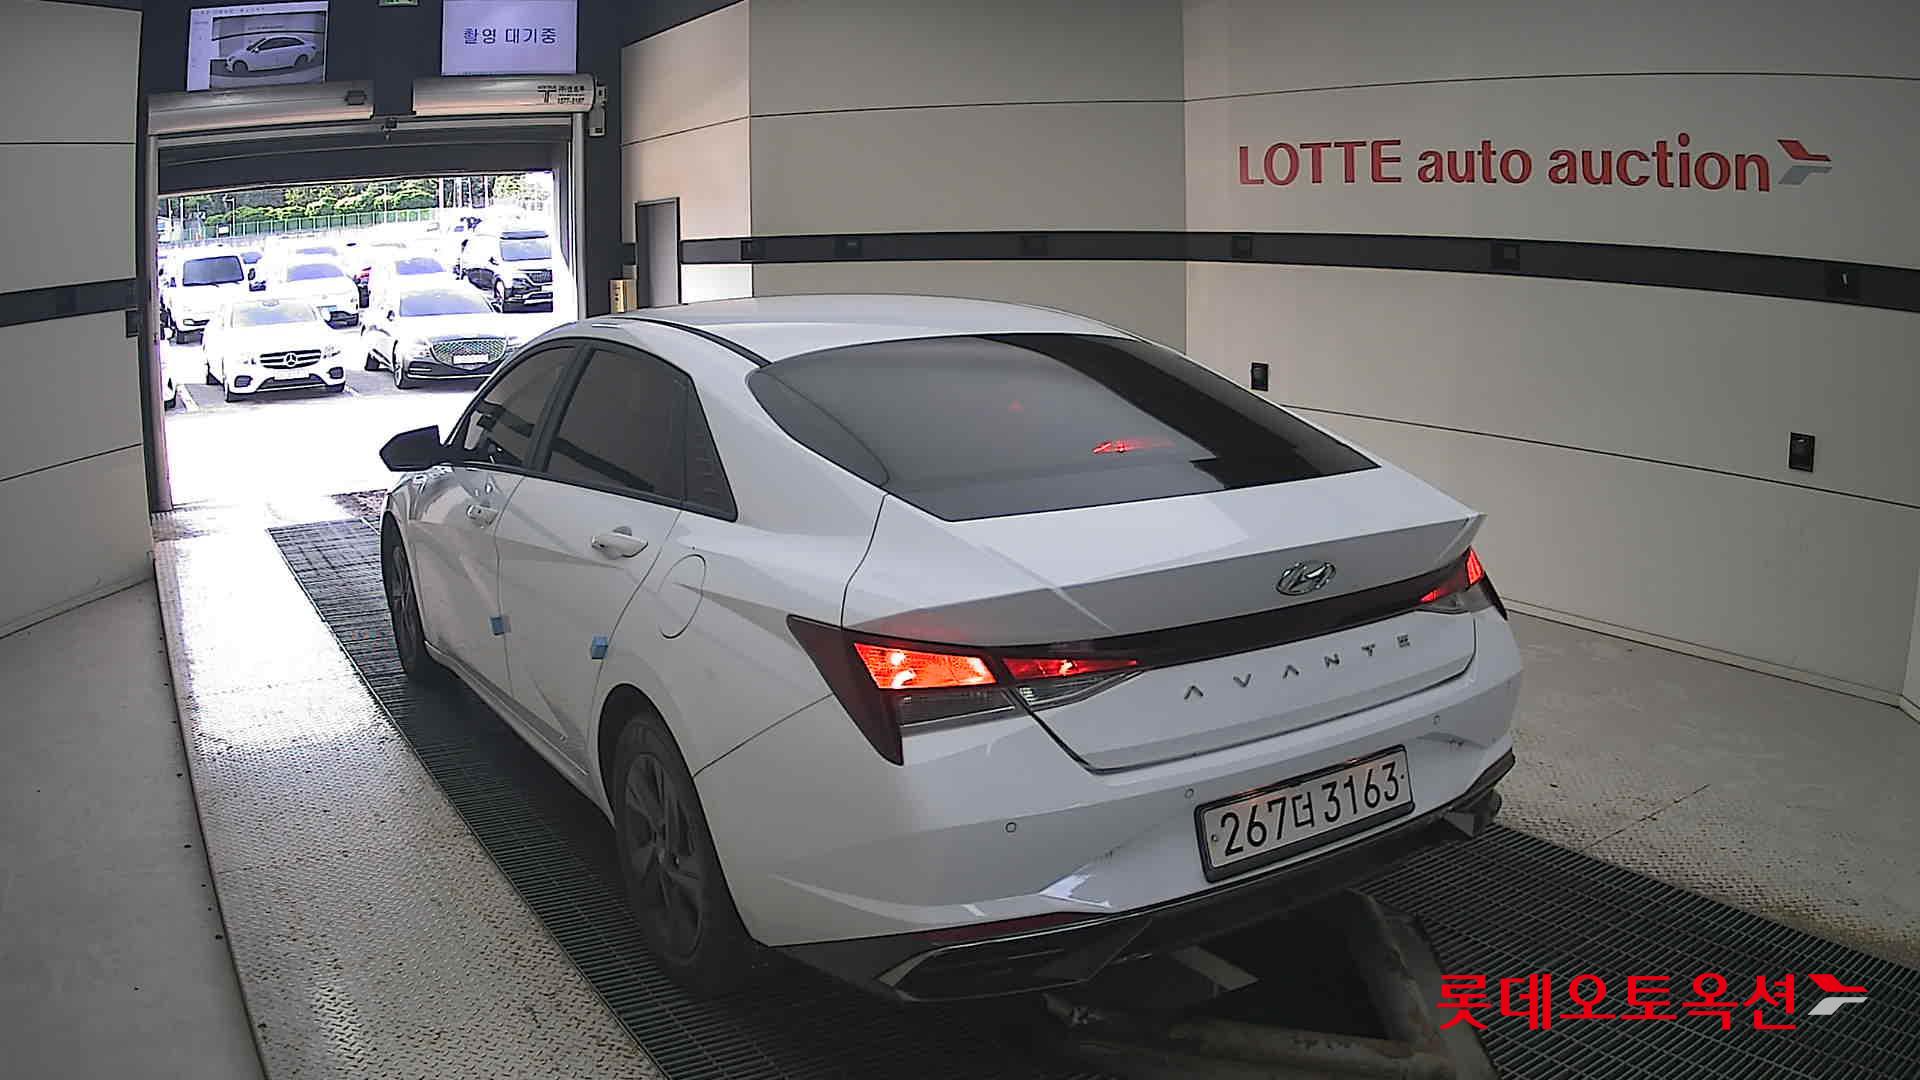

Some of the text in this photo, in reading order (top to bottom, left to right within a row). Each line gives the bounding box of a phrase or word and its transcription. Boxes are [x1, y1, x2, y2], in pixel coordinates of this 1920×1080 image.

[464, 27, 557, 44] 촬영 대기중
[1238, 132, 1771, 192] LOTTE auto auction
[1183, 634, 1411, 700] AVANTE
